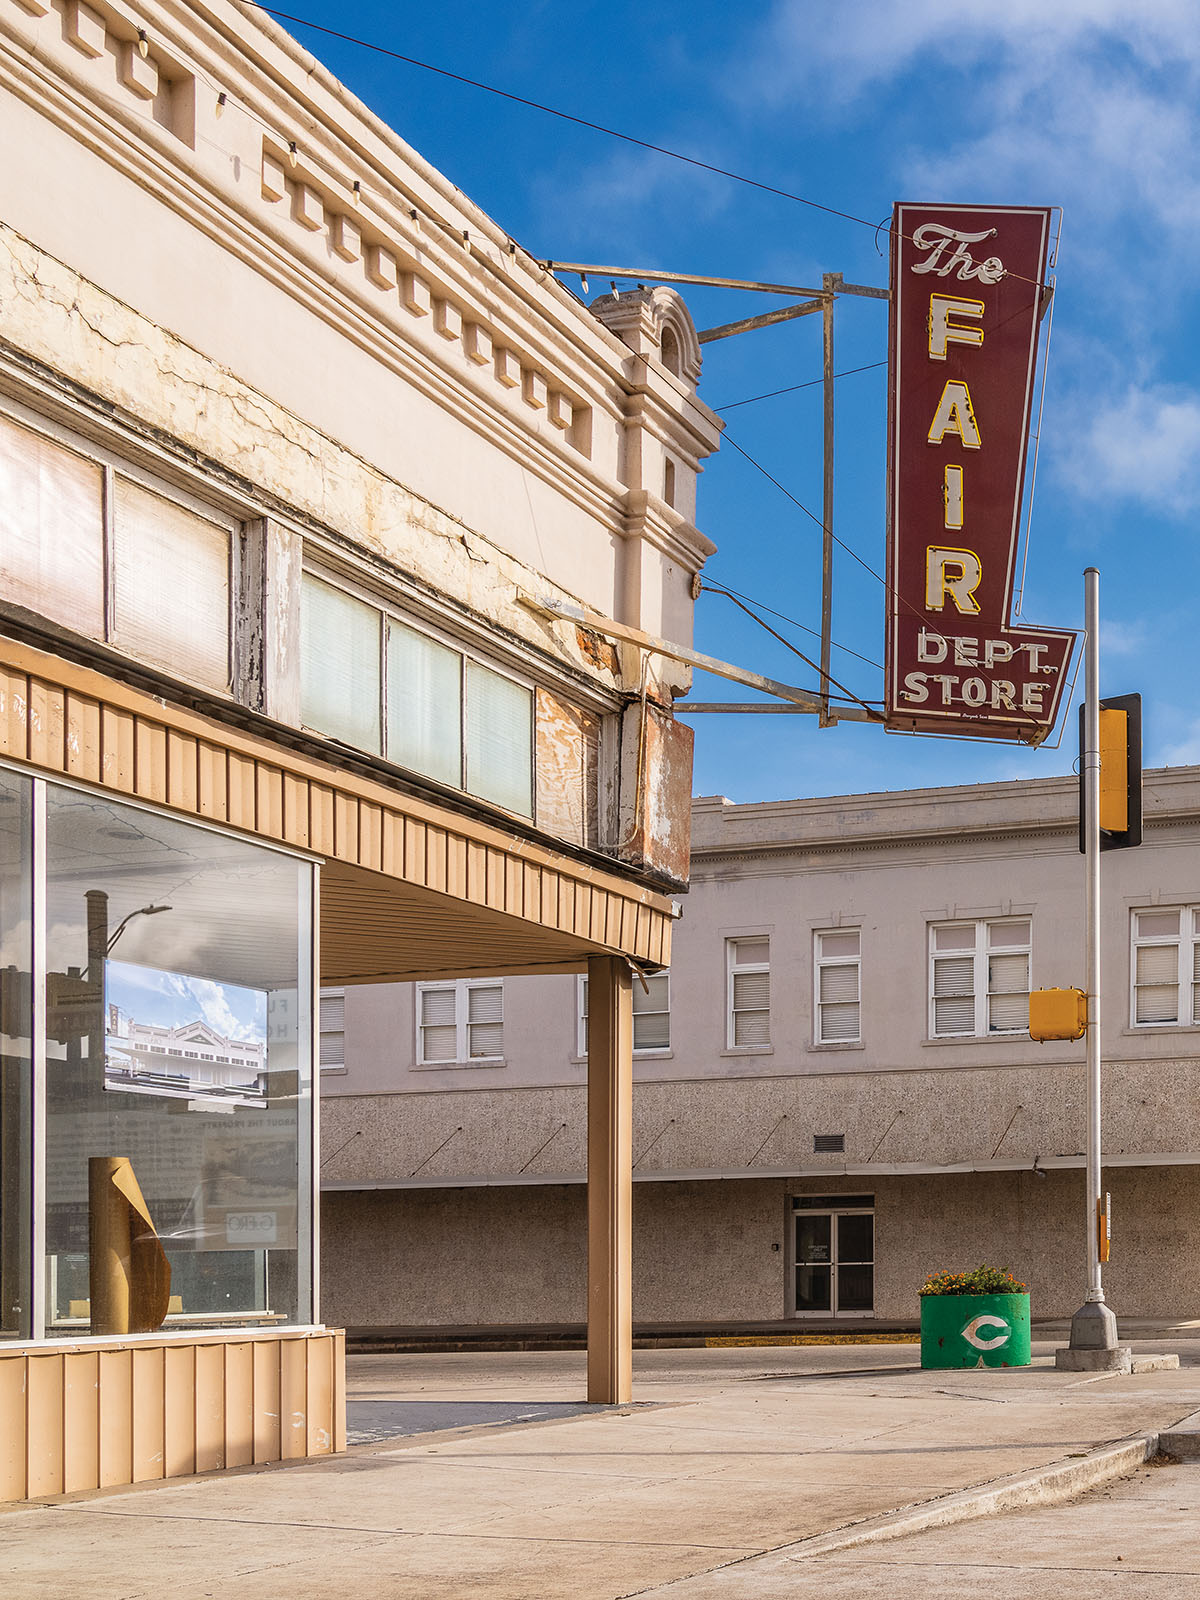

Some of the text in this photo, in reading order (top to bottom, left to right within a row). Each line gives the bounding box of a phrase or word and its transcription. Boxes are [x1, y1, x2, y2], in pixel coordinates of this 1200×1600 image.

[910, 223, 1007, 285] The
[925, 293, 984, 615] FAIR
[902, 672, 1046, 713] STORE
[961, 1314, 1009, 1350] C
